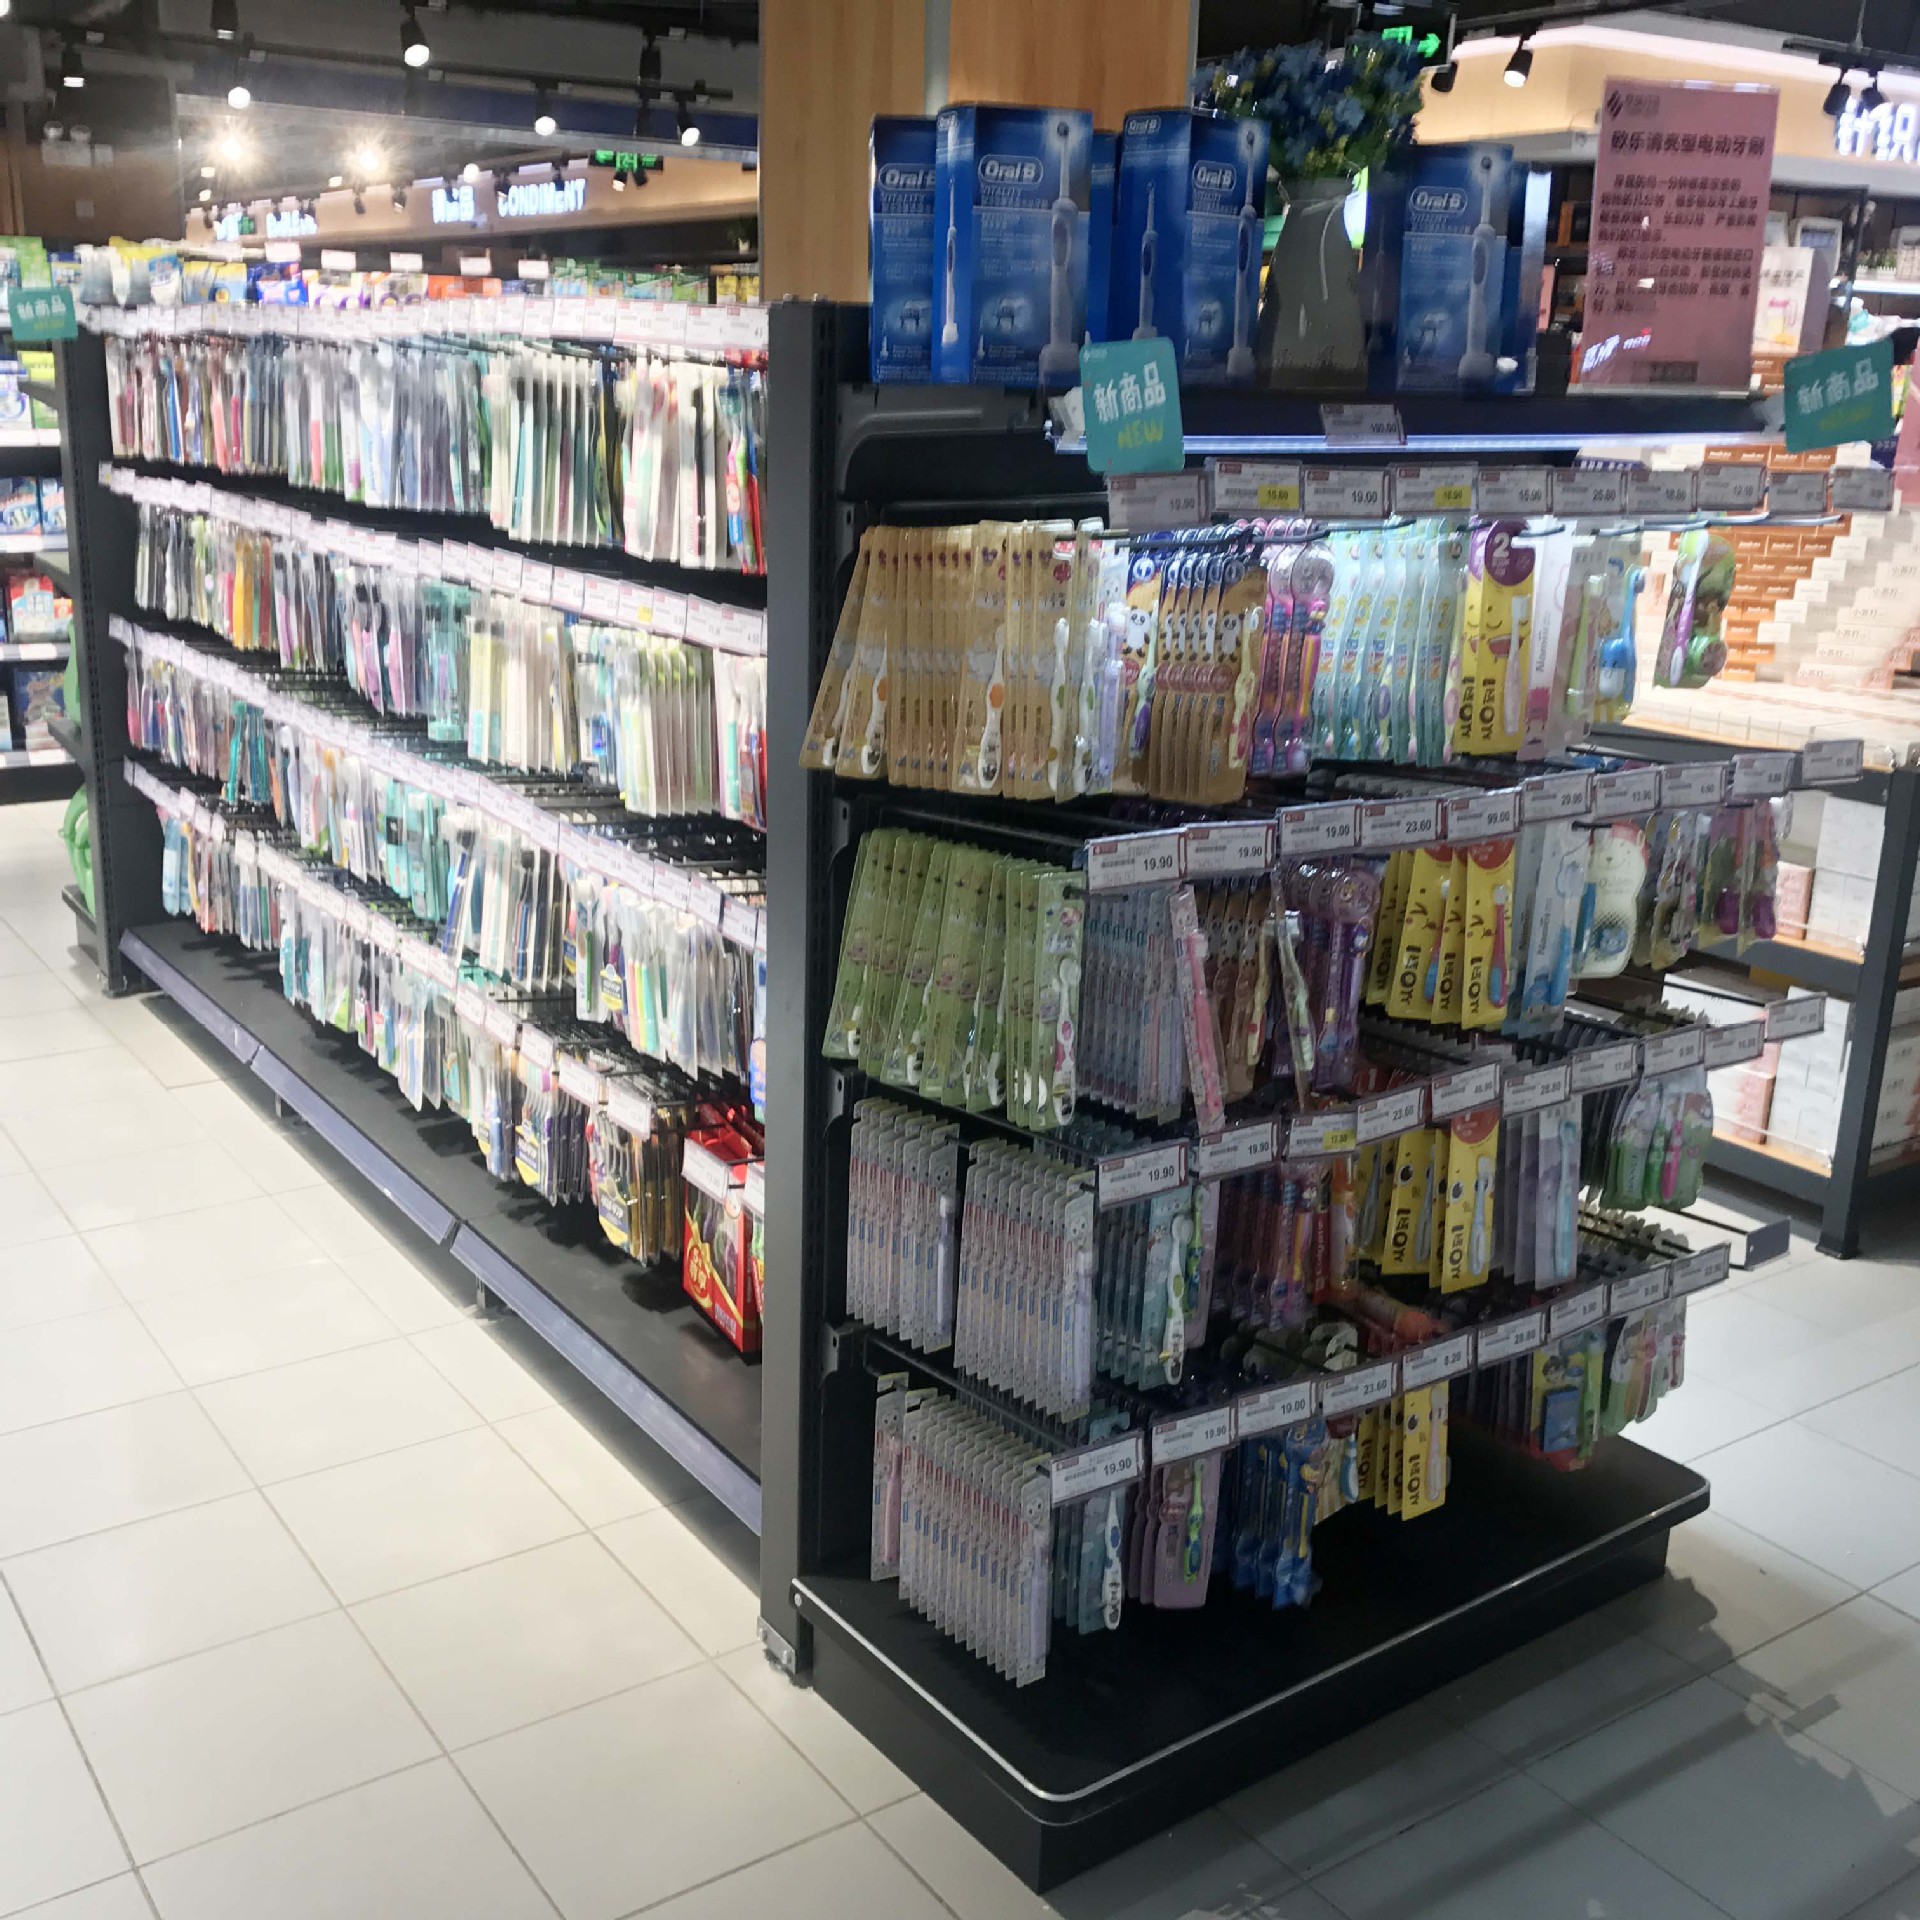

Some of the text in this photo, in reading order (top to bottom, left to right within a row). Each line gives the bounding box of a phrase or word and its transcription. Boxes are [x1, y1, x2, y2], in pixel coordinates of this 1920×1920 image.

[1838, 95, 1920, 166] 针织
[1094, 360, 1166, 423] 新商品
[1118, 418, 1164, 448] NEW
[1493, 533, 1510, 558] 2
[1143, 855, 1174, 871] 19.90
[1147, 1164, 1175, 1183] 19.90
[1103, 1456, 1132, 1477] 19.90
